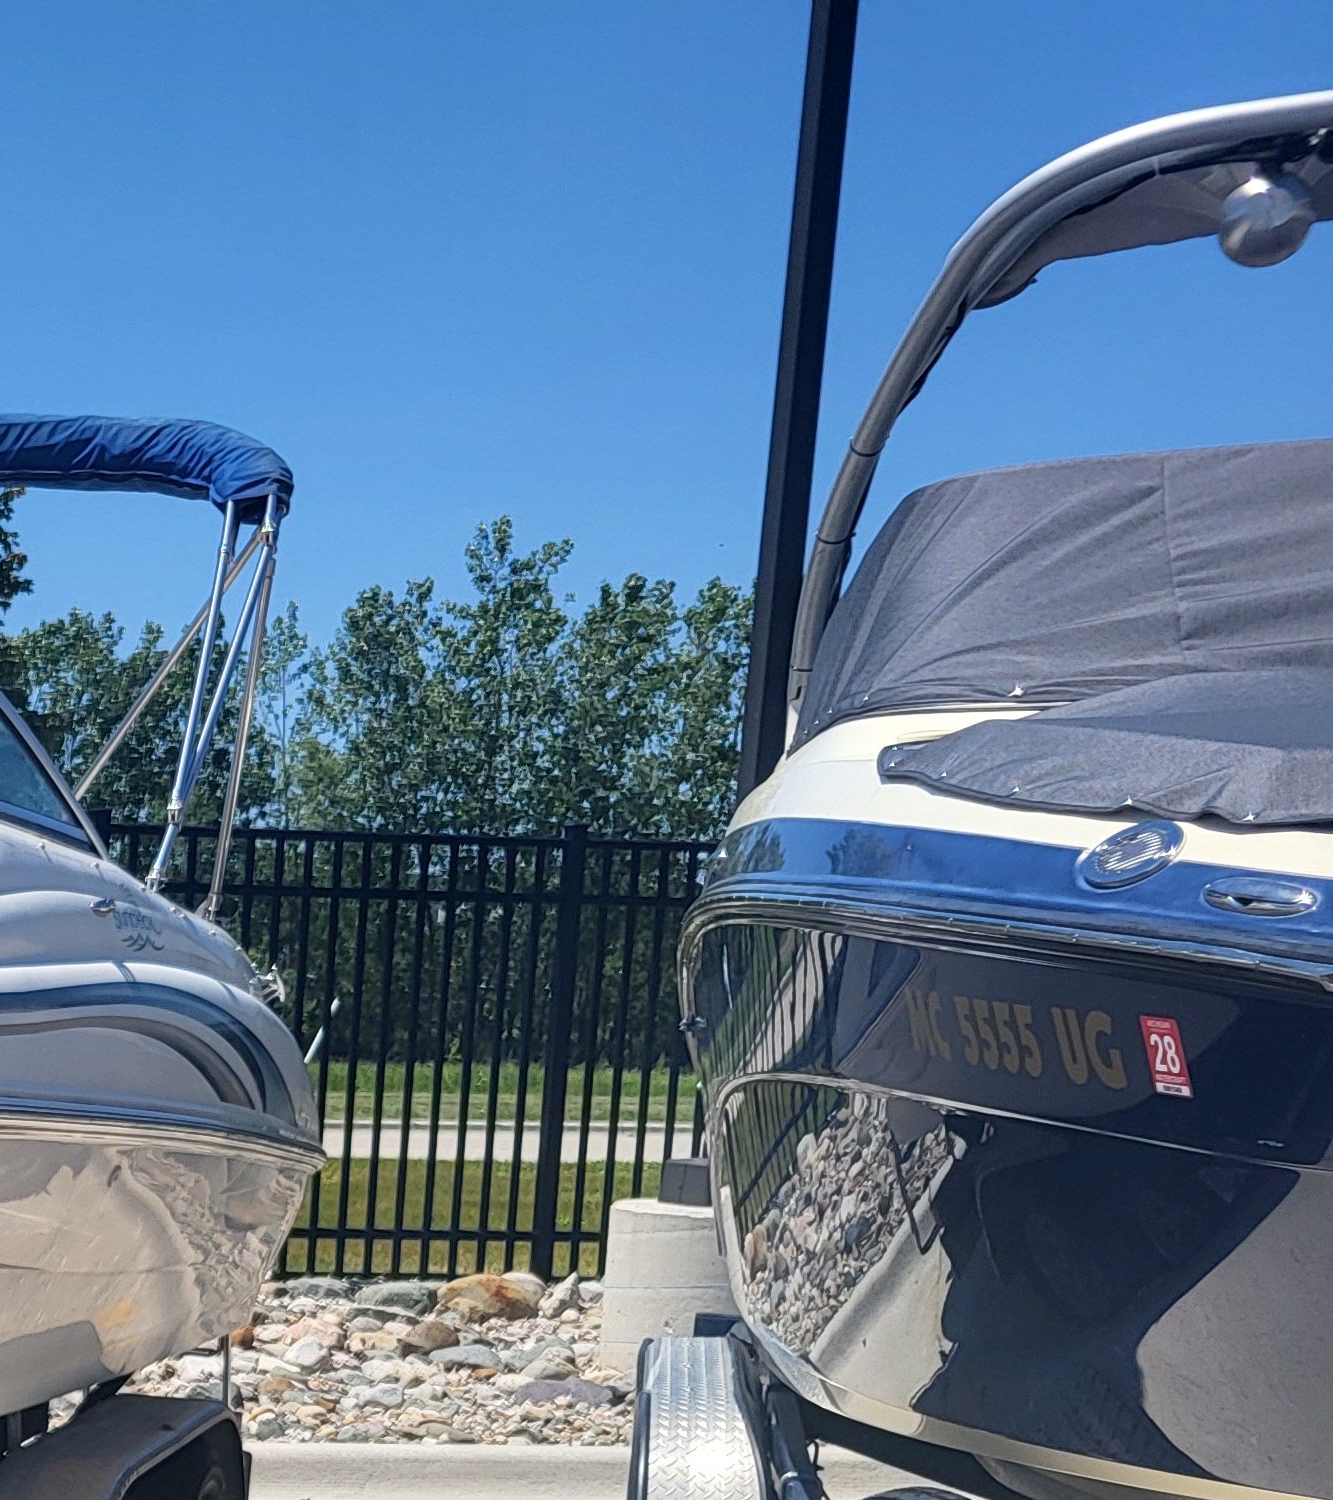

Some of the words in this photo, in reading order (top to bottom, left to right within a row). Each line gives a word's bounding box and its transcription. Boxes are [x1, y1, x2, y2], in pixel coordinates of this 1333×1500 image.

[904, 986, 950, 1059] MC
[953, 994, 1043, 1078] 5555
[1050, 1006, 1128, 1090] UG
[1149, 1033, 1181, 1074] 28
